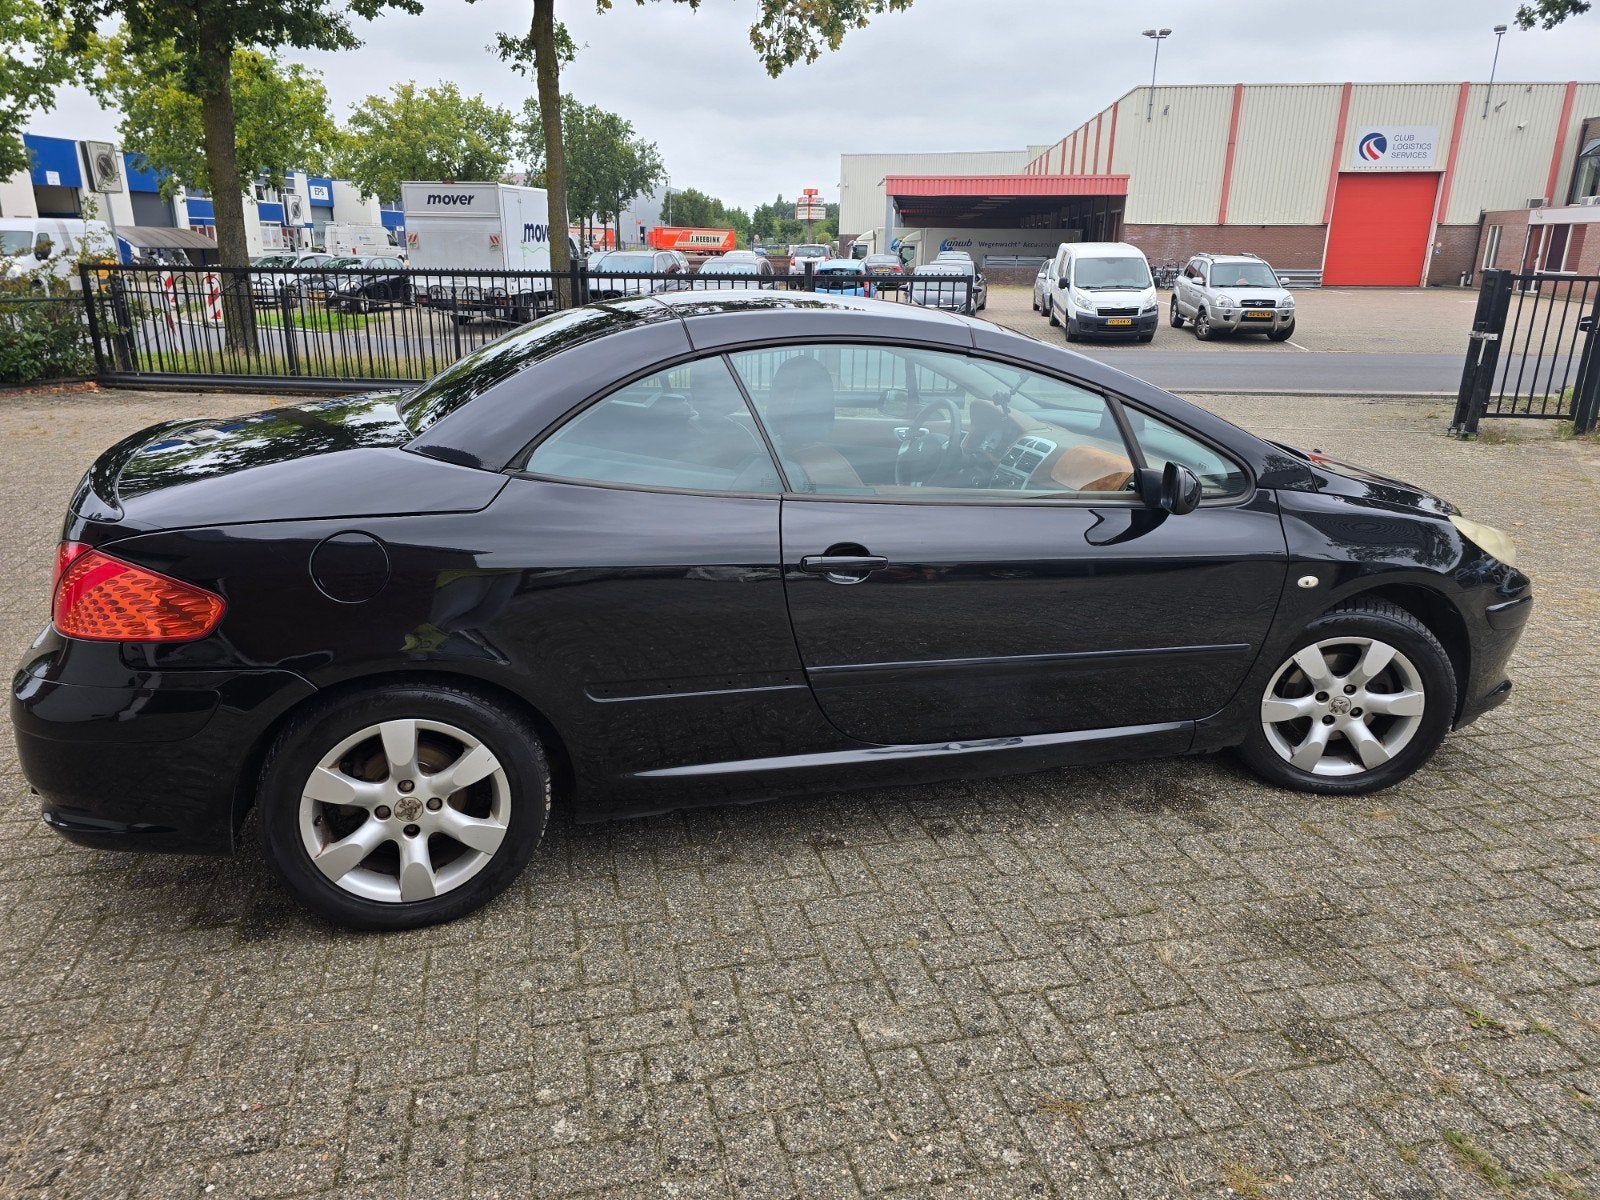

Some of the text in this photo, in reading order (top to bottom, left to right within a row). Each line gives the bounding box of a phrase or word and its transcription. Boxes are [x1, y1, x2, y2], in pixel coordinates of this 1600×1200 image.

[1392, 142, 1432, 150] LOGISTICS
[1391, 151, 1428, 159] SERVICES
[426, 194, 475, 205] mover
